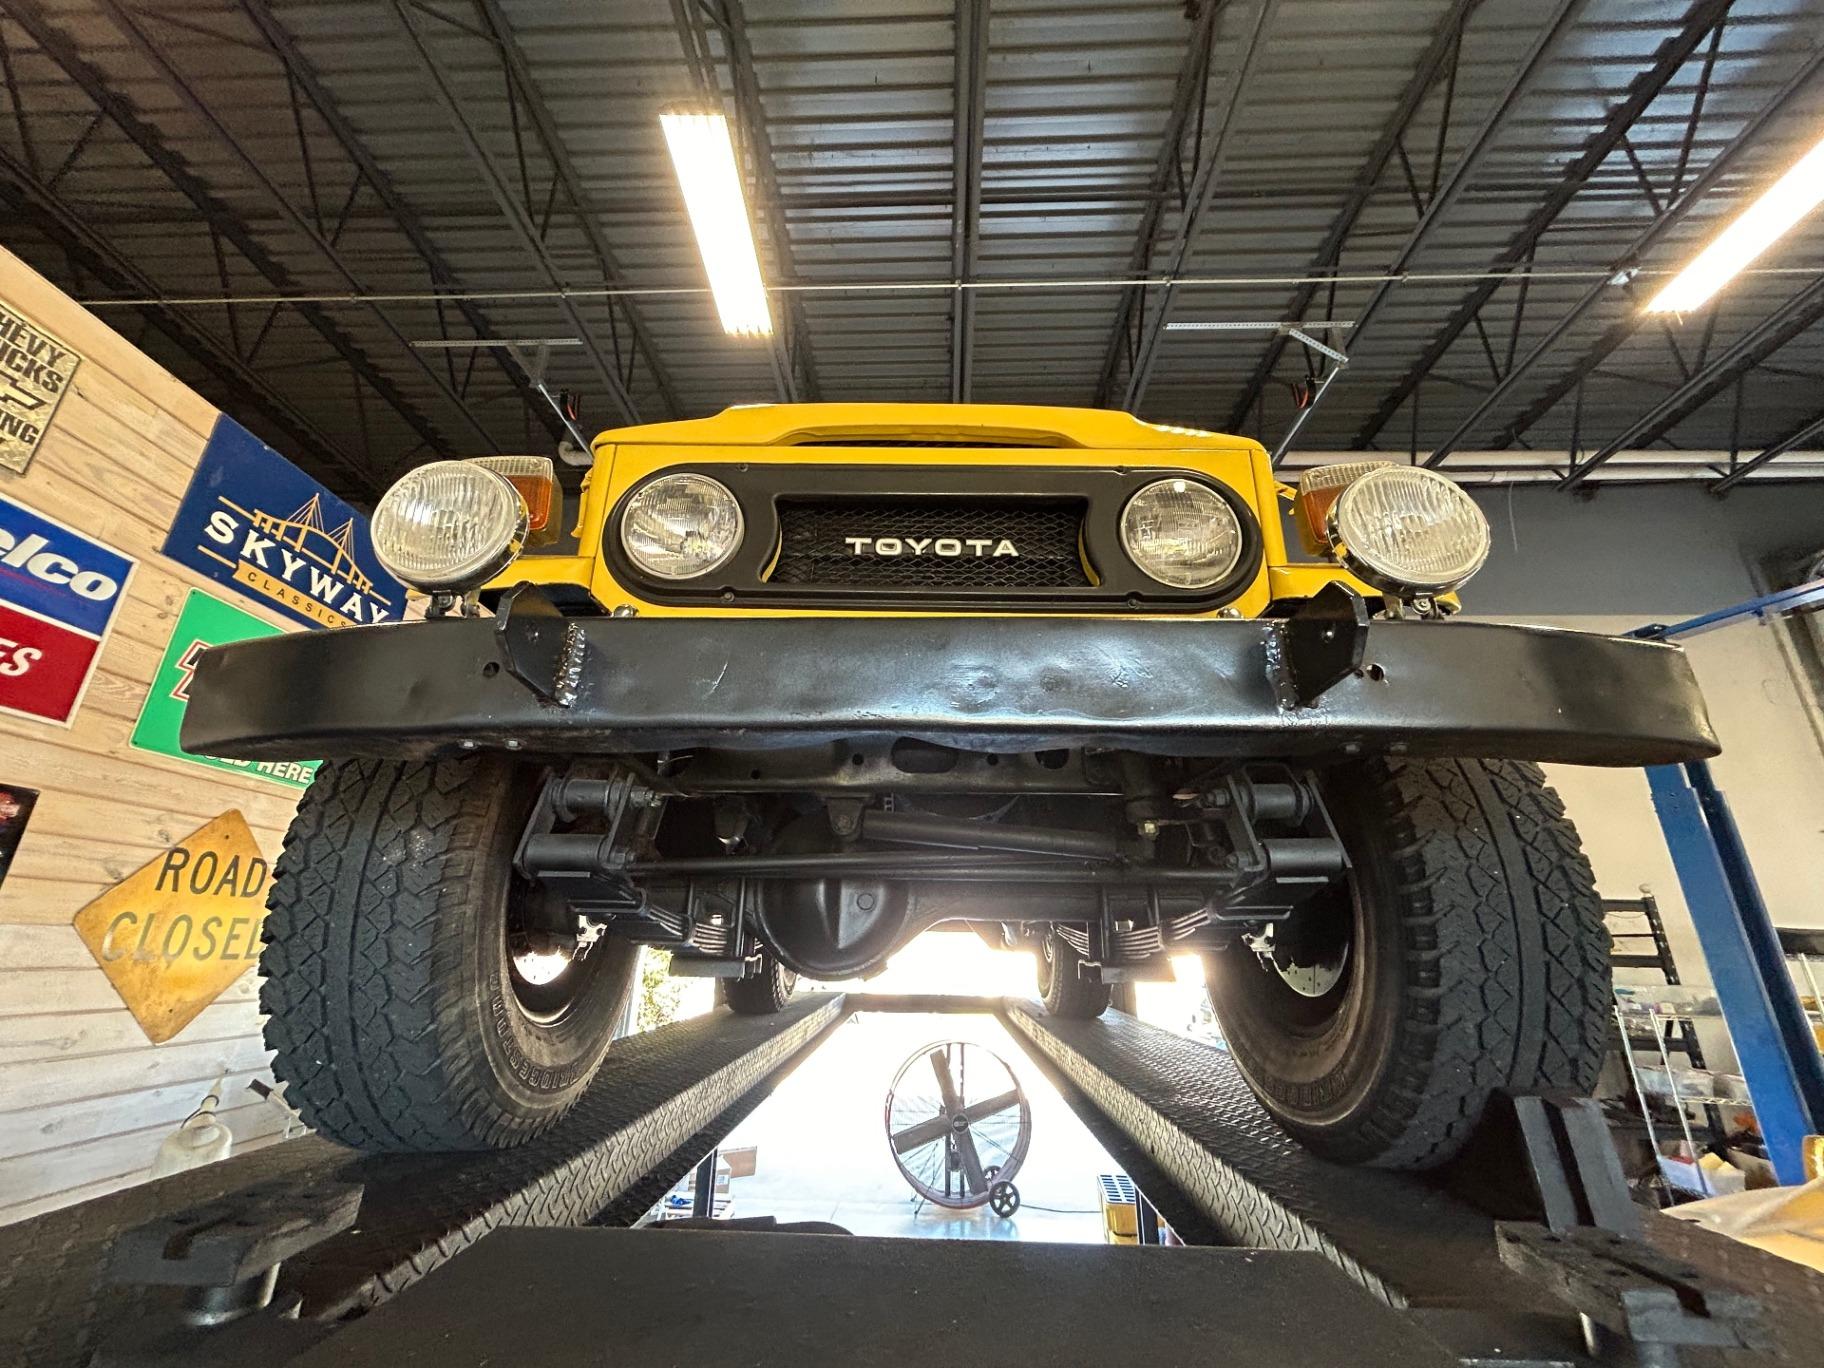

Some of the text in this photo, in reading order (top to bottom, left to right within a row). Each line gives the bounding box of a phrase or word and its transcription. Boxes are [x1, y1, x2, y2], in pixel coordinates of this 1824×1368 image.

[845, 537, 1019, 557] TOYOTA
[204, 511, 389, 623] SKYWAY
[256, 761, 314, 784] HERE
[155, 847, 268, 898] ROAD
